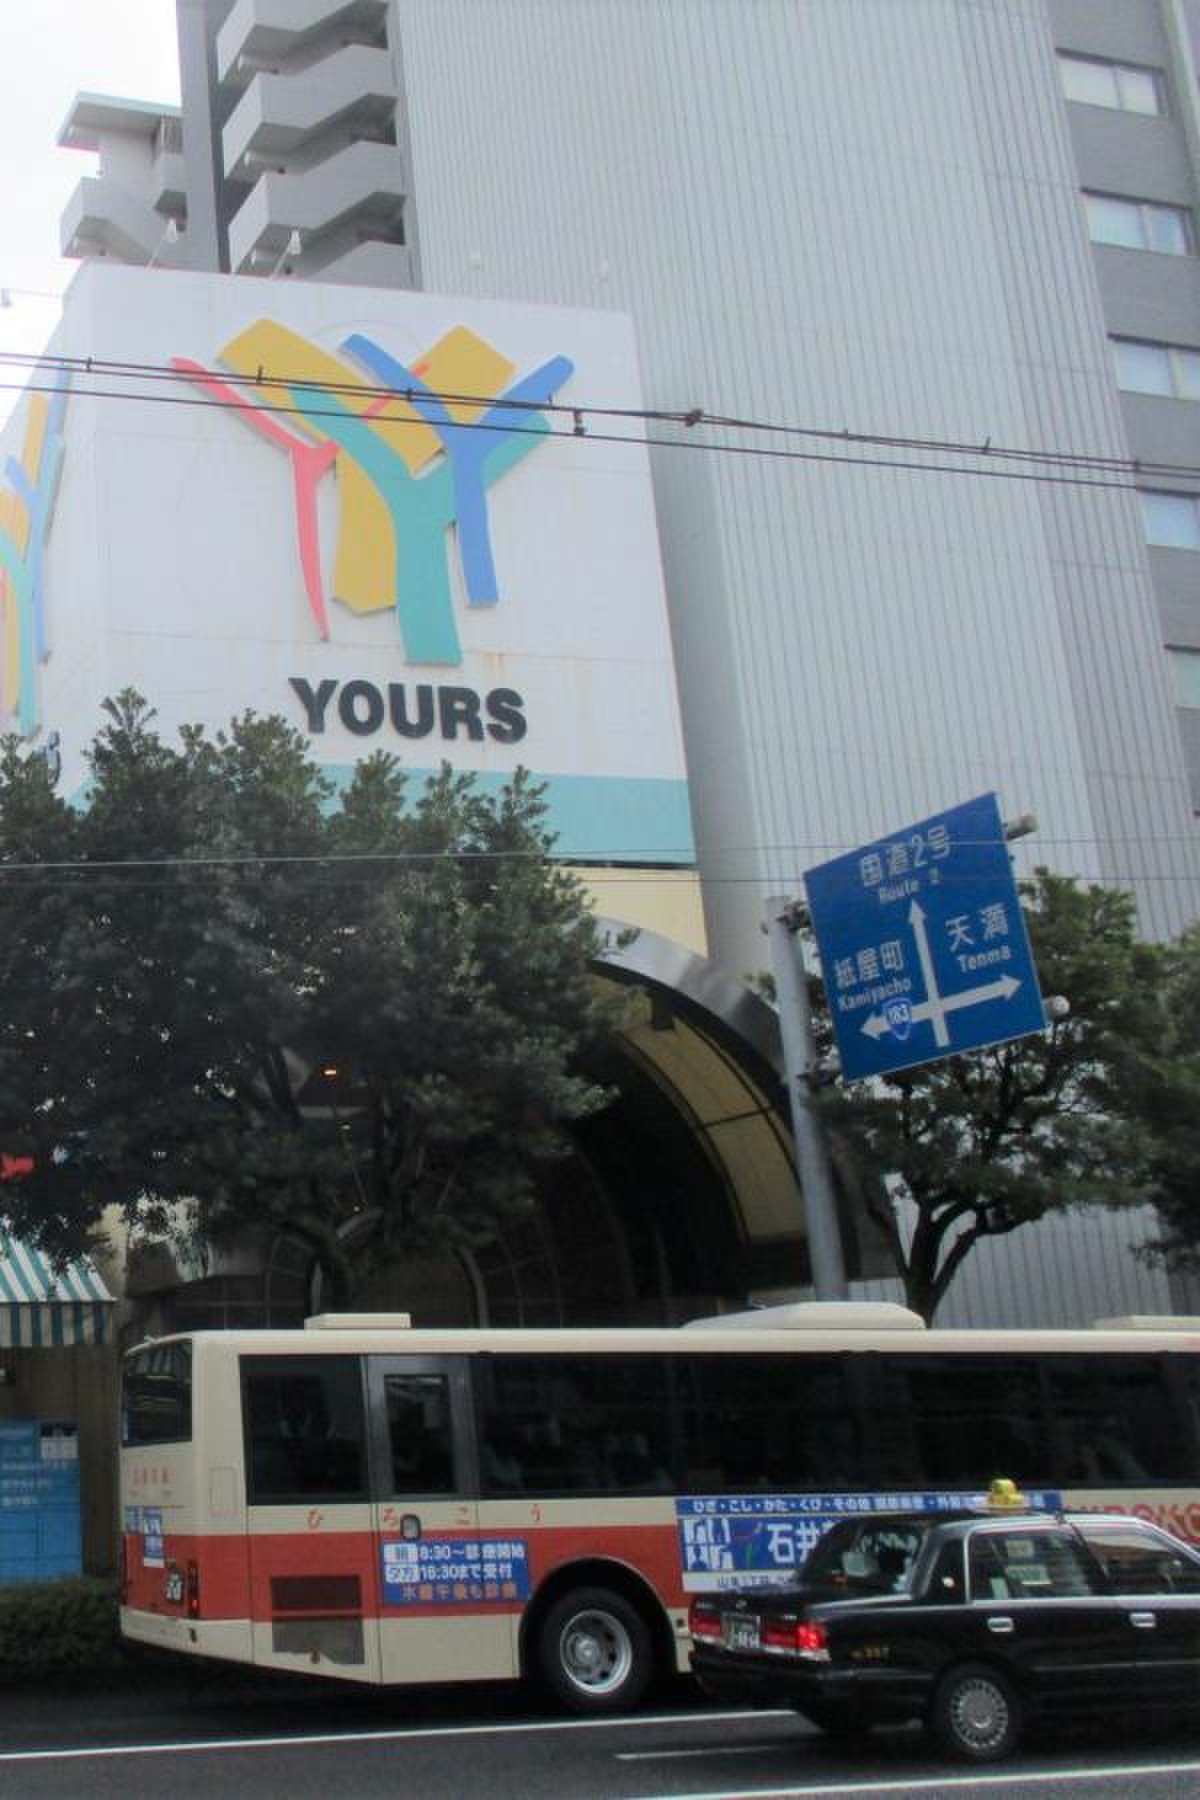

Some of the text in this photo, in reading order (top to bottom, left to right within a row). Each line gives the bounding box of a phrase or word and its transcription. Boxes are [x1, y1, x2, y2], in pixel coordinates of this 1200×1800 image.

[288, 677, 528, 745] YOURS
[879, 878, 920, 904] Route
[945, 903, 1009, 953] 天満
[958, 945, 1012, 974] Tenma
